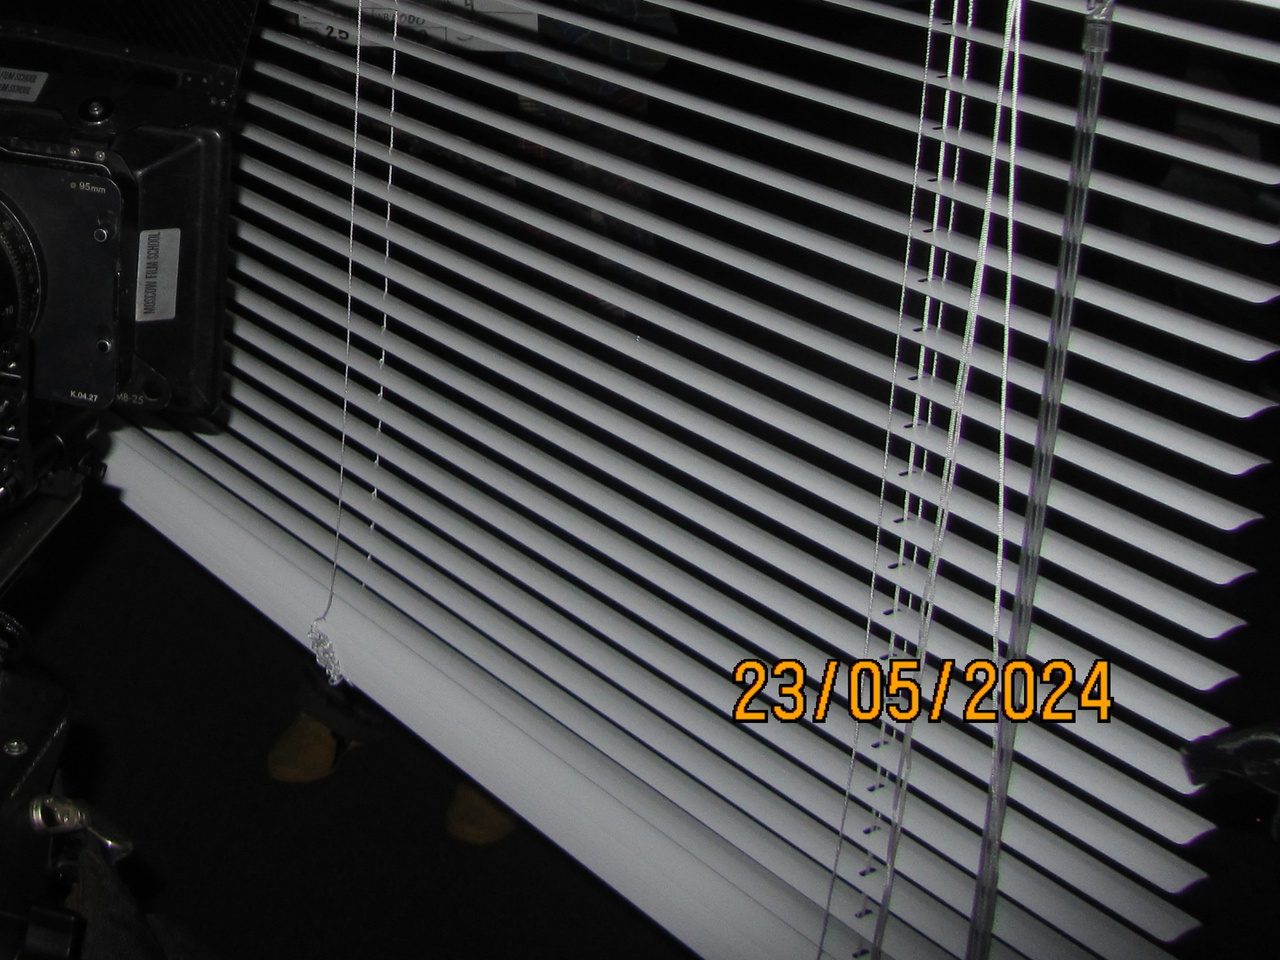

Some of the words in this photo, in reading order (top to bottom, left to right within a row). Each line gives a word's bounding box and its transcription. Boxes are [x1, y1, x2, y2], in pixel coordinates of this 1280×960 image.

[79, 181, 106, 194] 95mm
[147, 231, 161, 260] SCHOOL
[145, 261, 158, 280] FILM
[143, 281, 158, 315] MOSCOW
[69, 389, 99, 403] K.04.27
